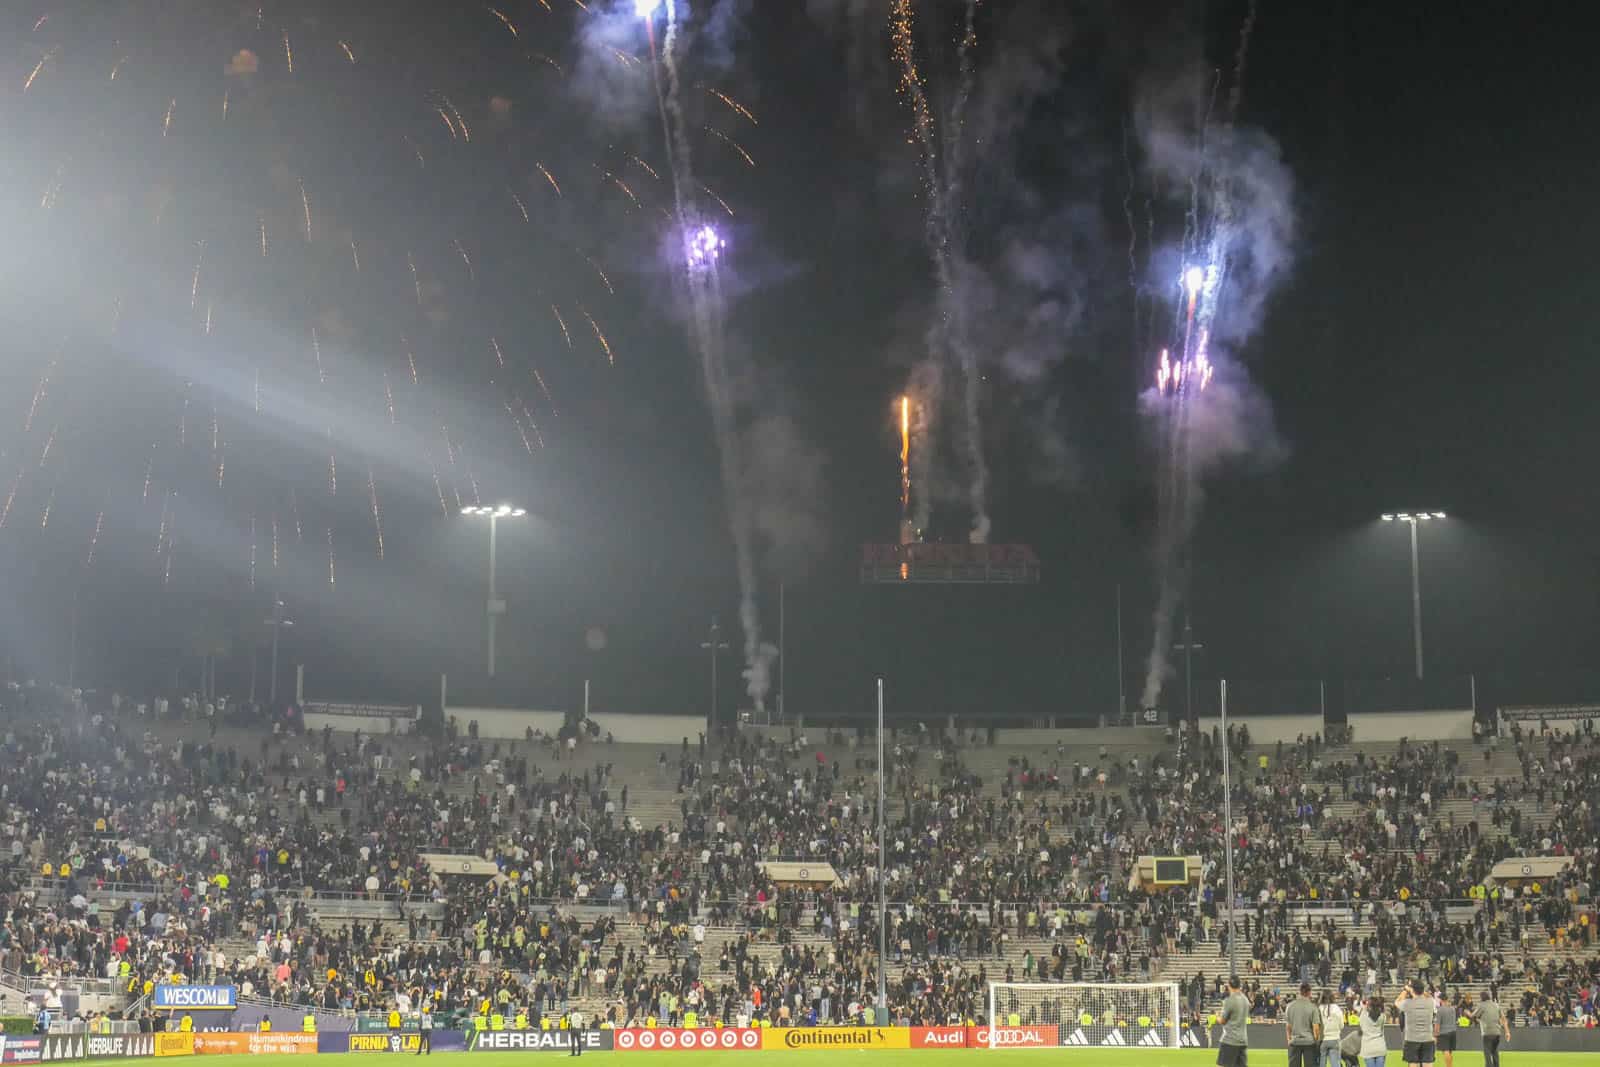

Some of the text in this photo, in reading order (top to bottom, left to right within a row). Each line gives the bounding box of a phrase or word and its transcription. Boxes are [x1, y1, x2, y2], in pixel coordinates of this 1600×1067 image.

[164, 988, 217, 1005] WESCOM
[87, 1037, 123, 1054] HERBALIFE
[351, 1036, 388, 1050] PIRNIA
[479, 1032, 601, 1048] HERBALIFE
[785, 1029, 871, 1048] Continental
[924, 1031, 964, 1044] Audi
